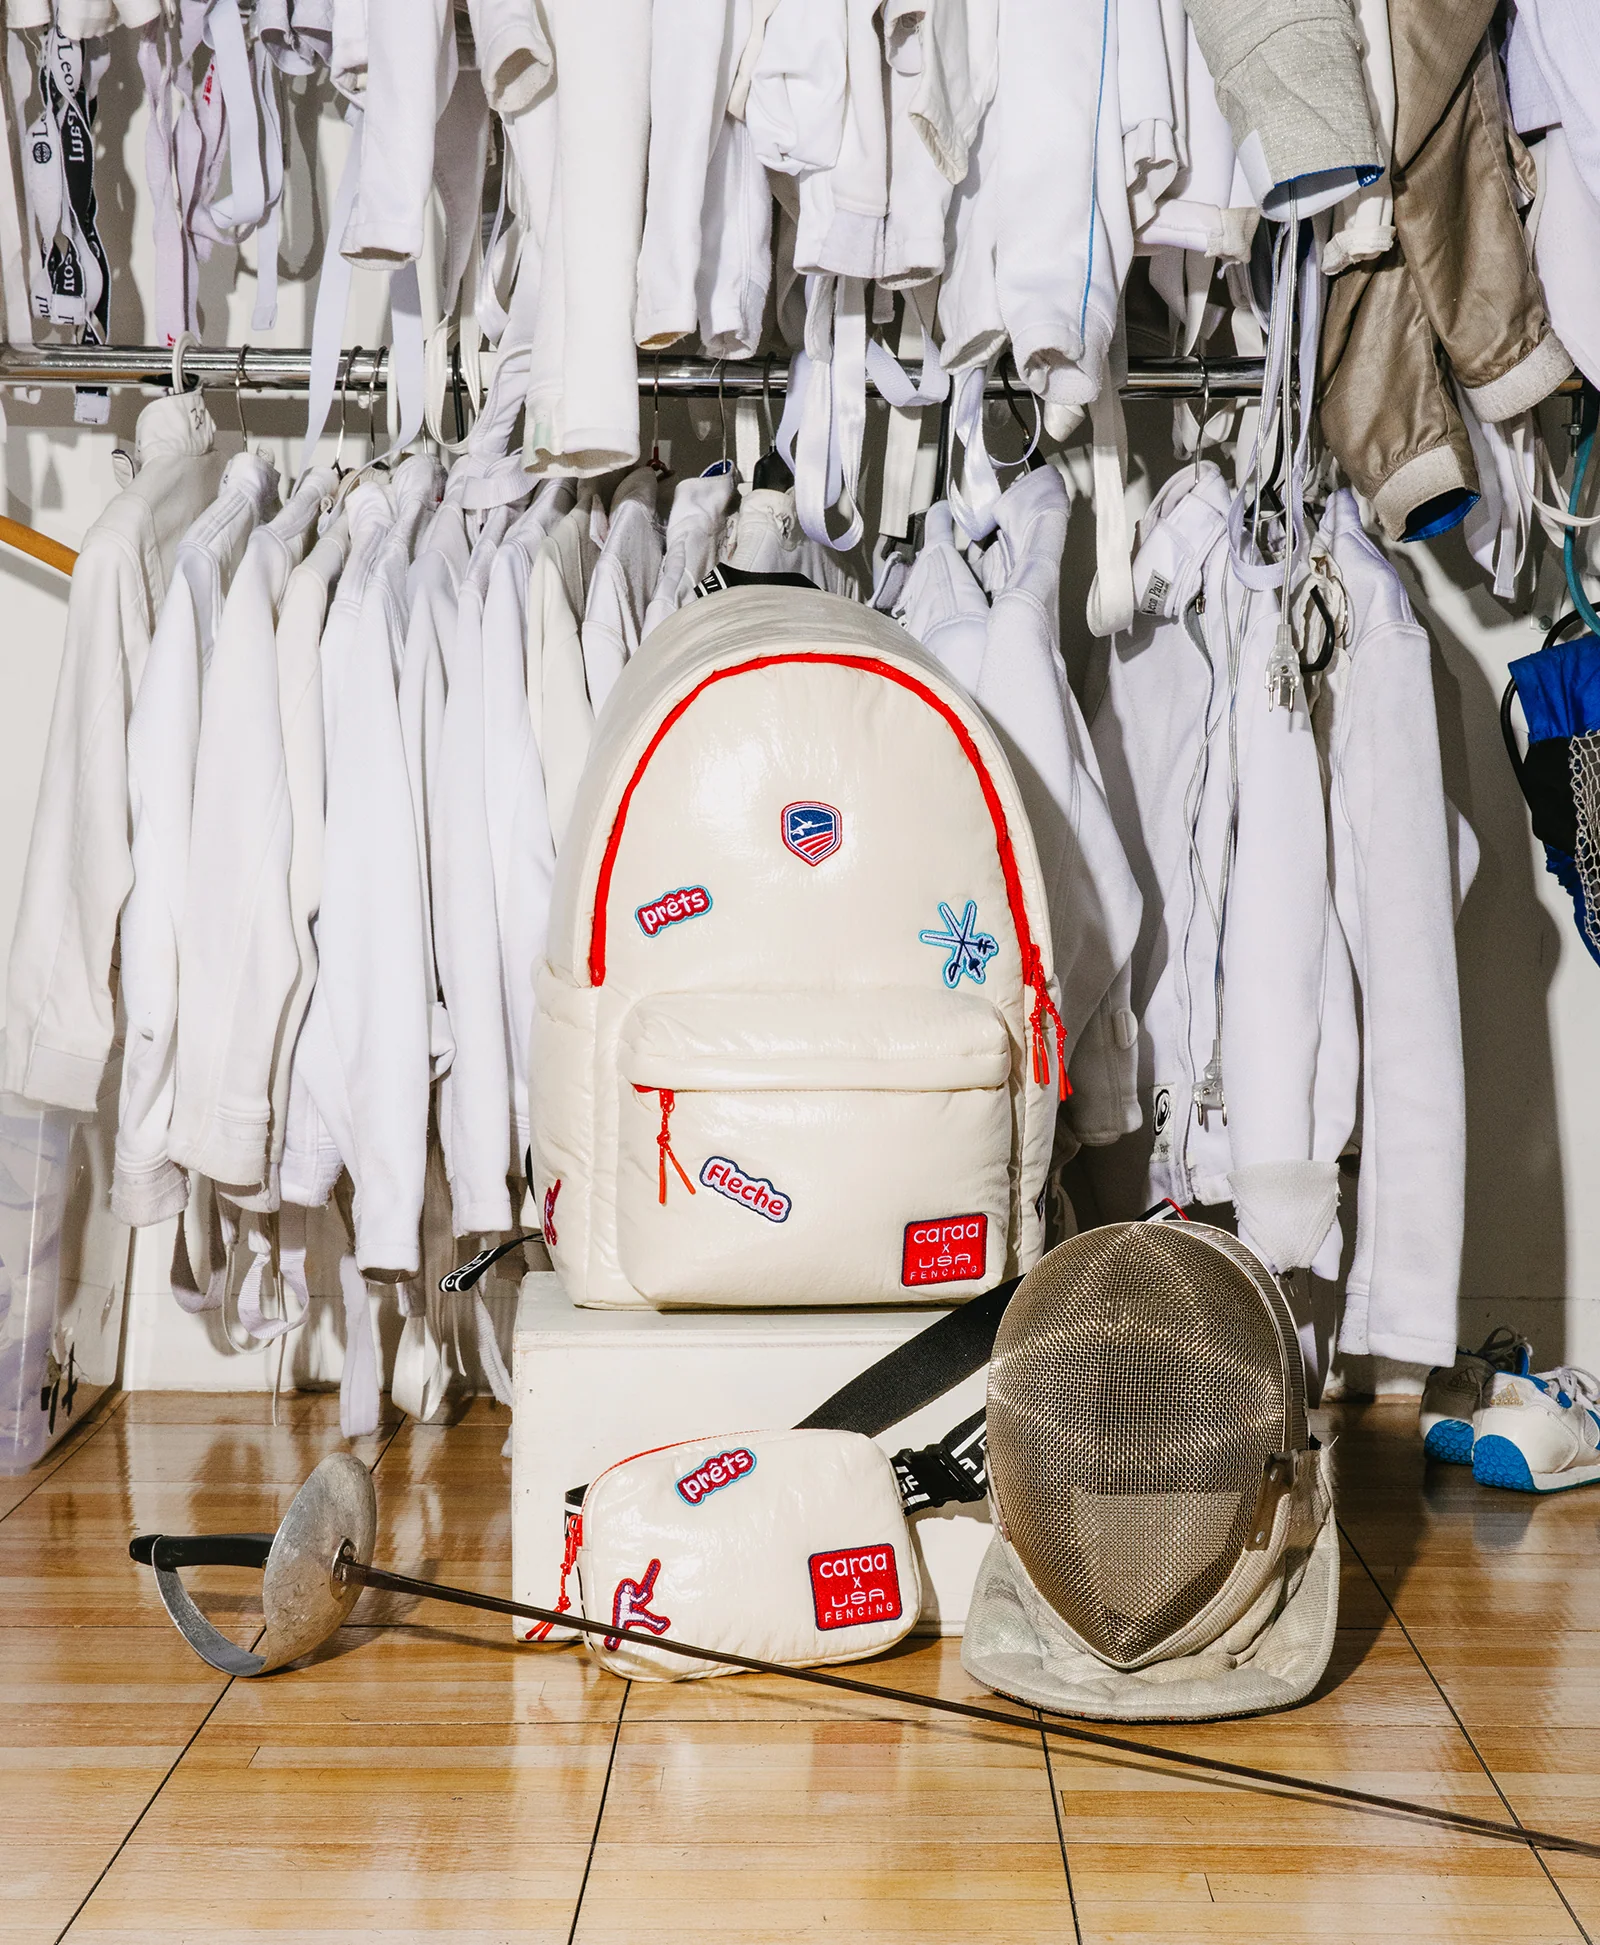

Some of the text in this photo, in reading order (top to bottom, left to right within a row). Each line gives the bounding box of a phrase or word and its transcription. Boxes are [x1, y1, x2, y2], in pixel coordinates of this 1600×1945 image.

[1148, 575, 1166, 598] Paul
[641, 892, 705, 931] prêts
[707, 1163, 784, 1216] Fleche
[913, 1222, 979, 1244] caraa
[918, 1253, 972, 1269] USA
[909, 1265, 978, 1281] FENCING
[682, 1452, 749, 1500] prêts
[819, 1552, 888, 1579] caraa
[831, 1588, 885, 1608] USA
[824, 1602, 894, 1623] FENCING
